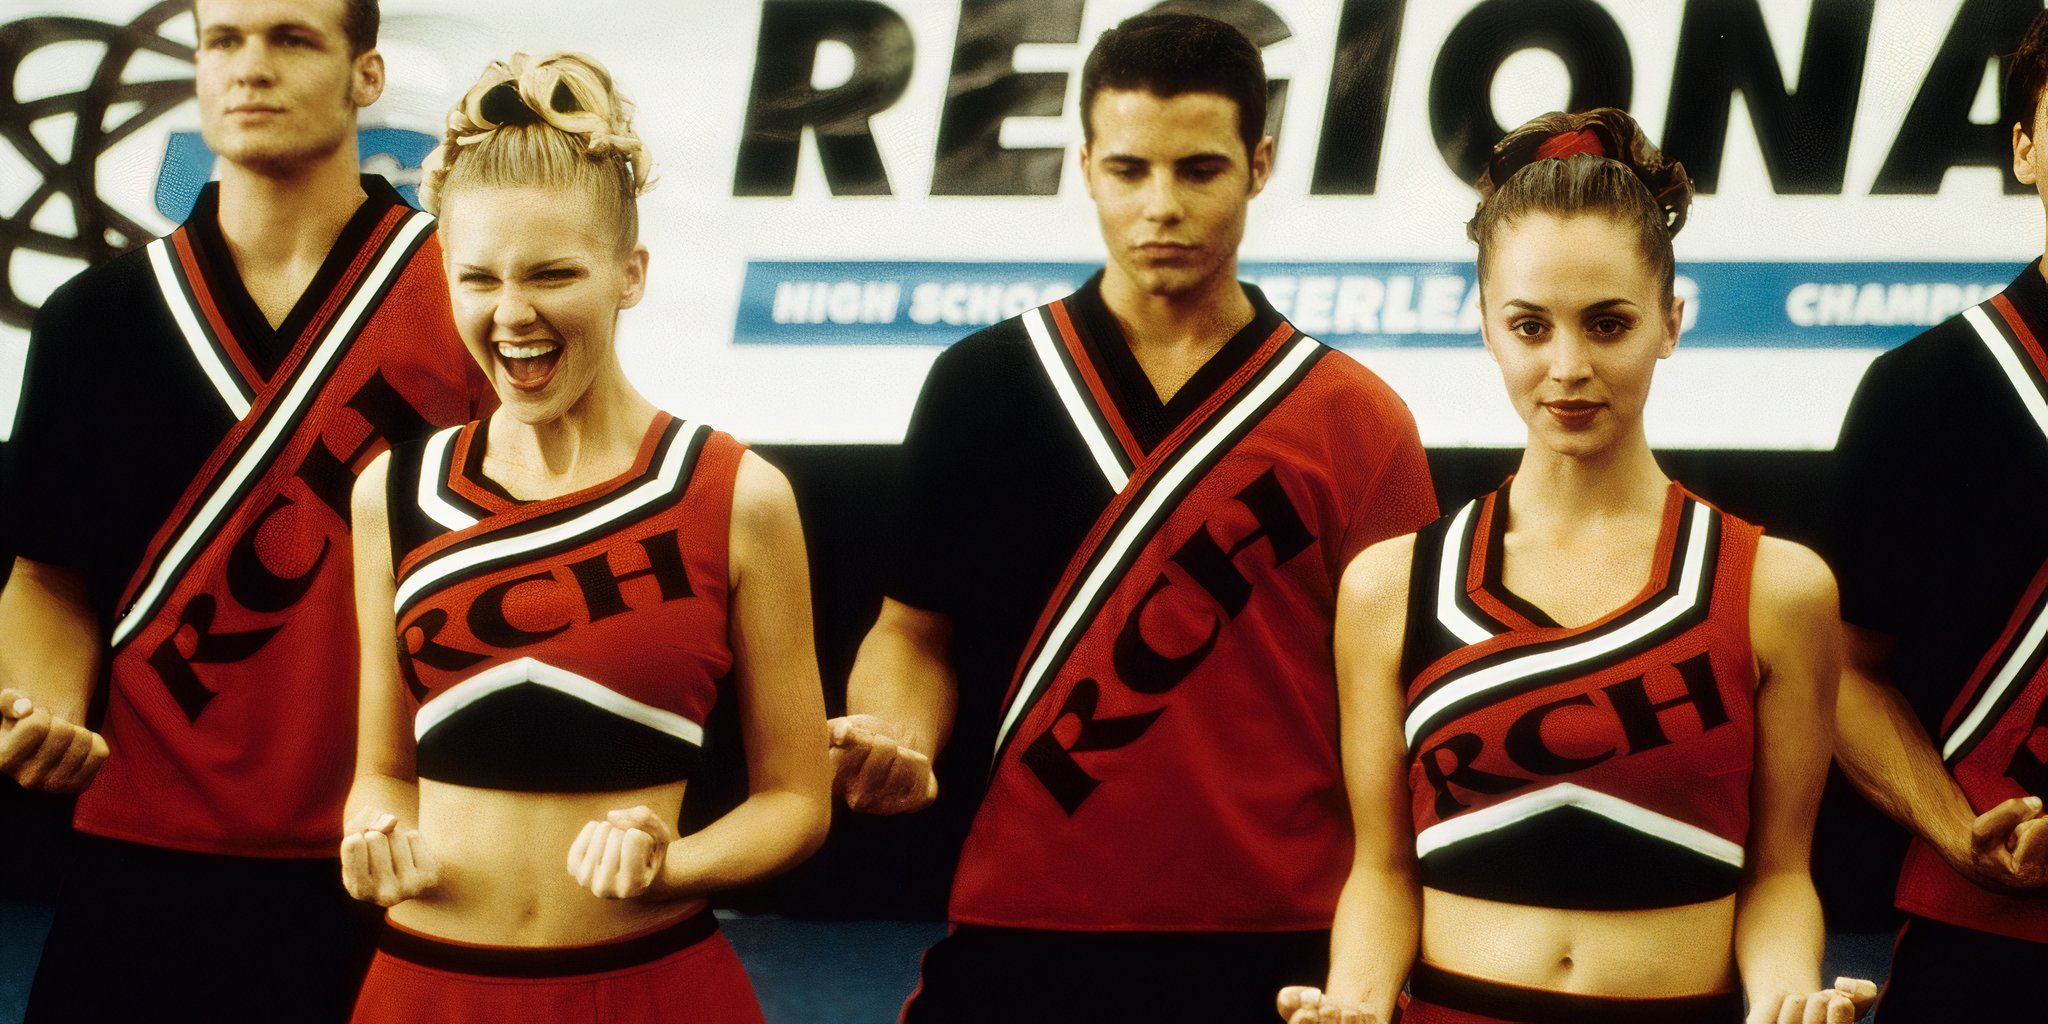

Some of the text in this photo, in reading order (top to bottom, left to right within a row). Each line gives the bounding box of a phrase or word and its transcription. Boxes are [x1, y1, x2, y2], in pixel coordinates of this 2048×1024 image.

[732, 0, 2042, 196] REIONA
[772, 280, 901, 324] HIGH
[397, 528, 698, 704] RCH
[1019, 467, 1319, 819] RCH
[1419, 650, 1735, 820] RCH
